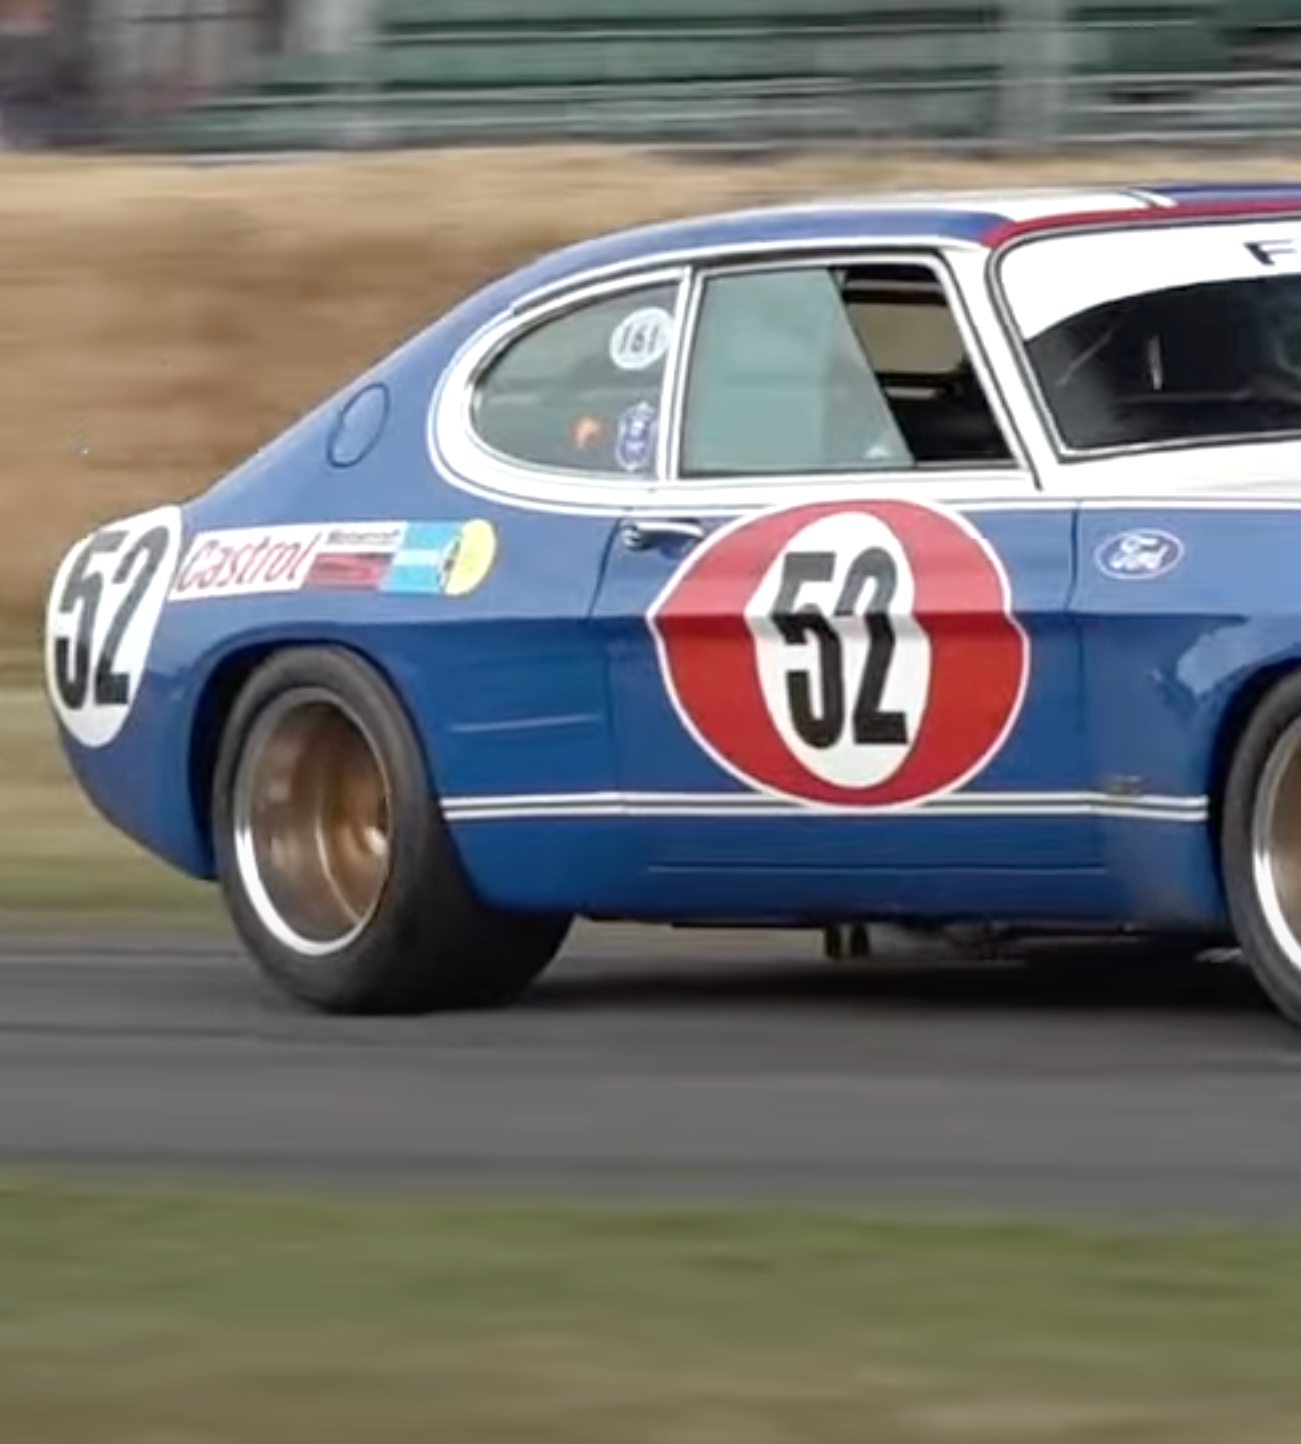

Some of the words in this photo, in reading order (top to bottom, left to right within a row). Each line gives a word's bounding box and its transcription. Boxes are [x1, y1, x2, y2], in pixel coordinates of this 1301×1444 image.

[54, 528, 171, 710] 52
[176, 532, 323, 592] Castrol
[770, 546, 909, 749] 52
